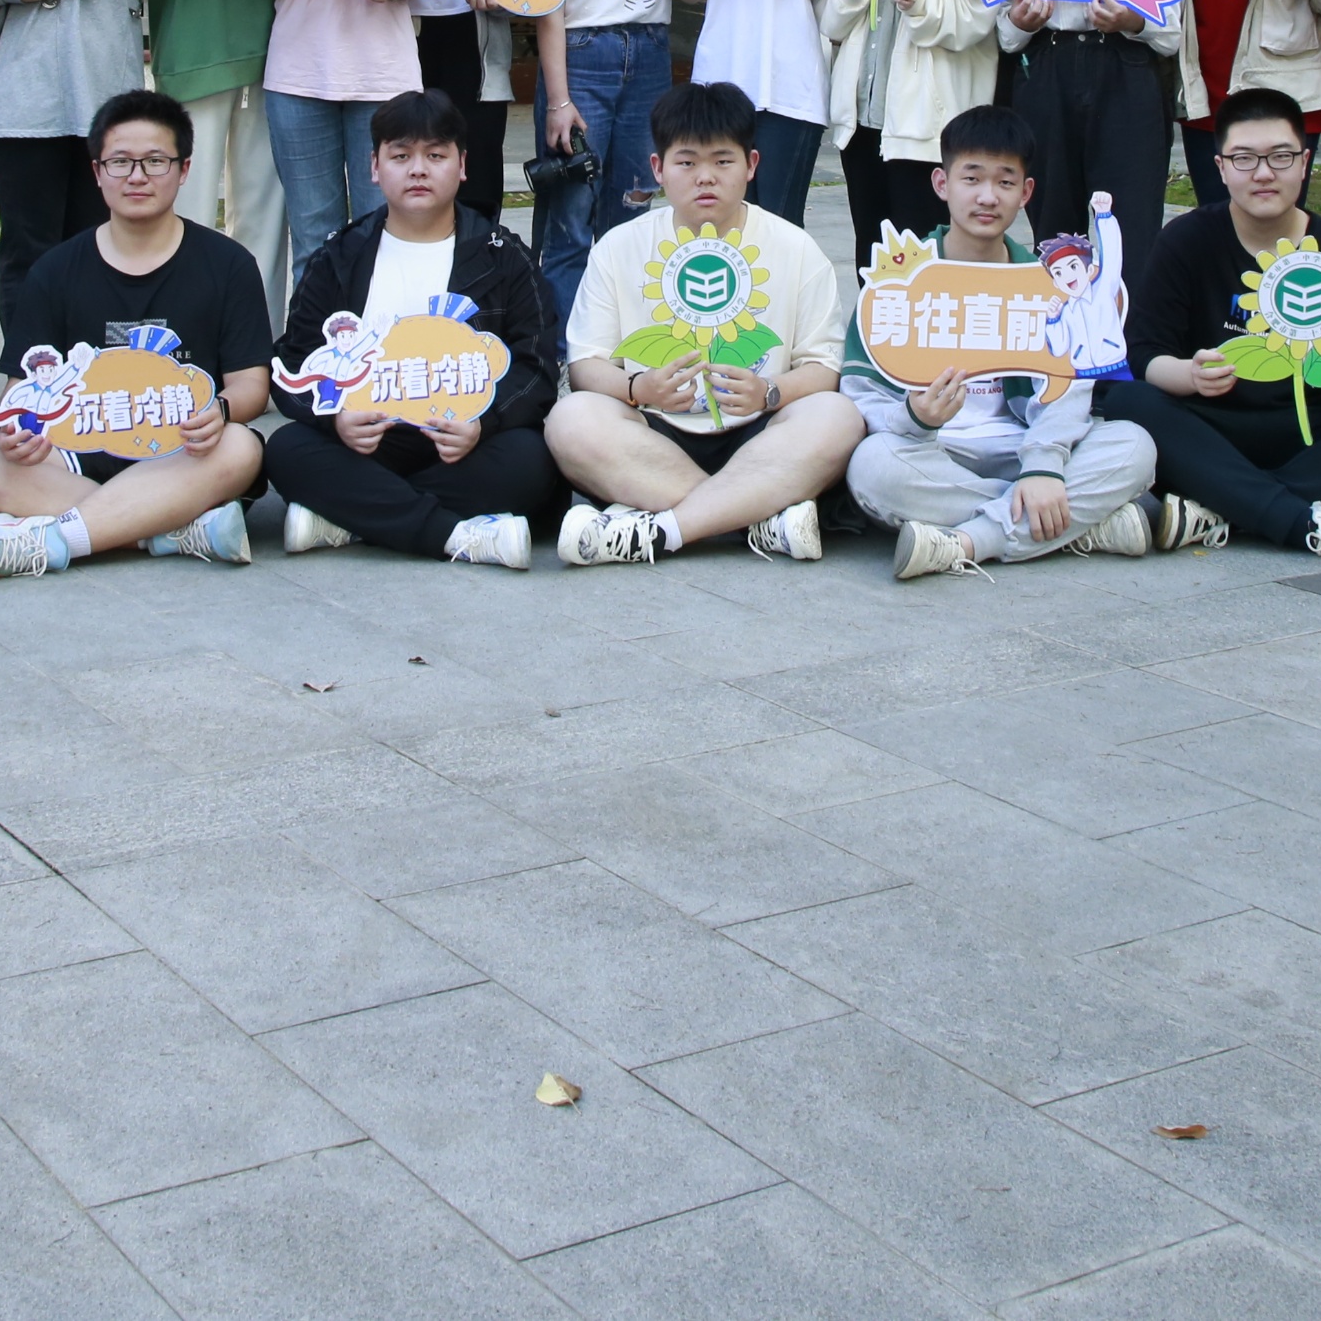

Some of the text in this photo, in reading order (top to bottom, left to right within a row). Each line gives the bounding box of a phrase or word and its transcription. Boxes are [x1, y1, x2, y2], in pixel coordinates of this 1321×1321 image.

[869, 289, 1049, 351] 勇往直前
[370, 351, 491, 403] 沉着冷静
[73, 384, 195, 435] 沉着冷静
